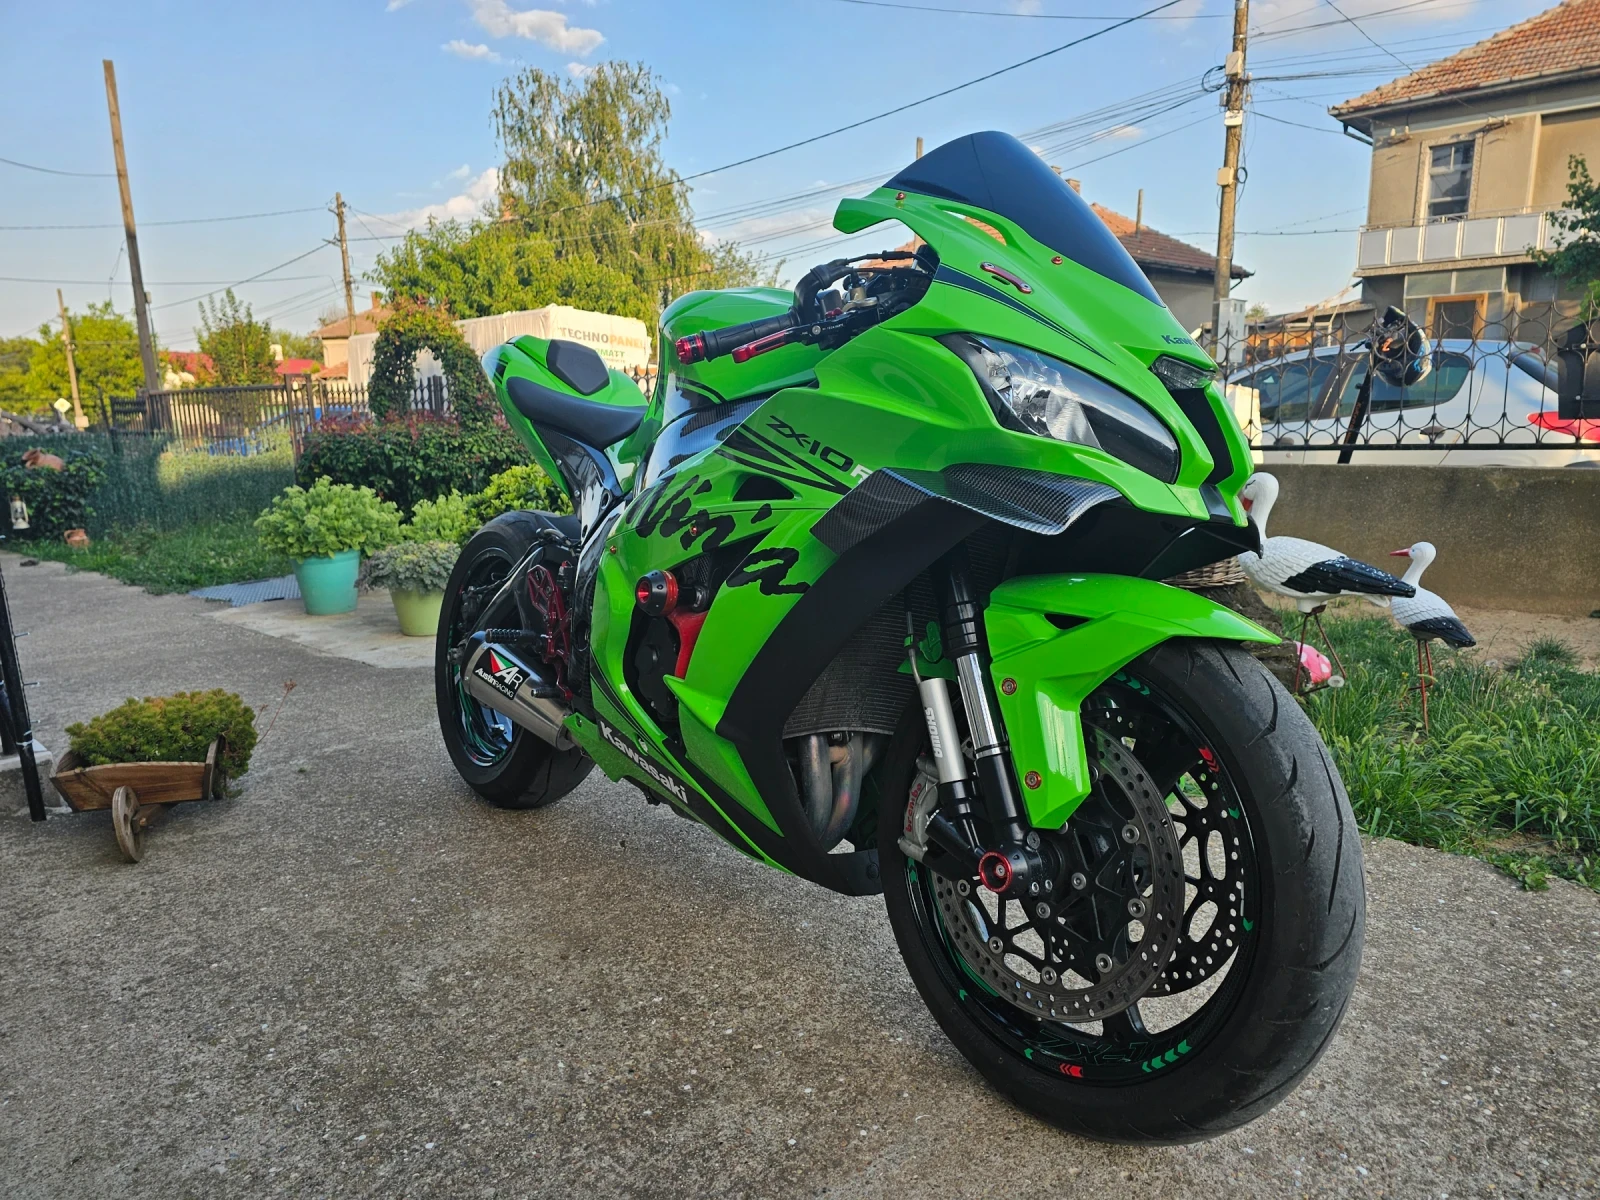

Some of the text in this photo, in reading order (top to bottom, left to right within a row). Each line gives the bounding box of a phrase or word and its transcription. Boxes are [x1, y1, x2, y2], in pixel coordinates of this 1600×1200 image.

[494, 666, 523, 690] AR
[924, 706, 943, 758] SHOWA
[600, 721, 688, 804] Kawasaki
[904, 783, 923, 833] brembo
